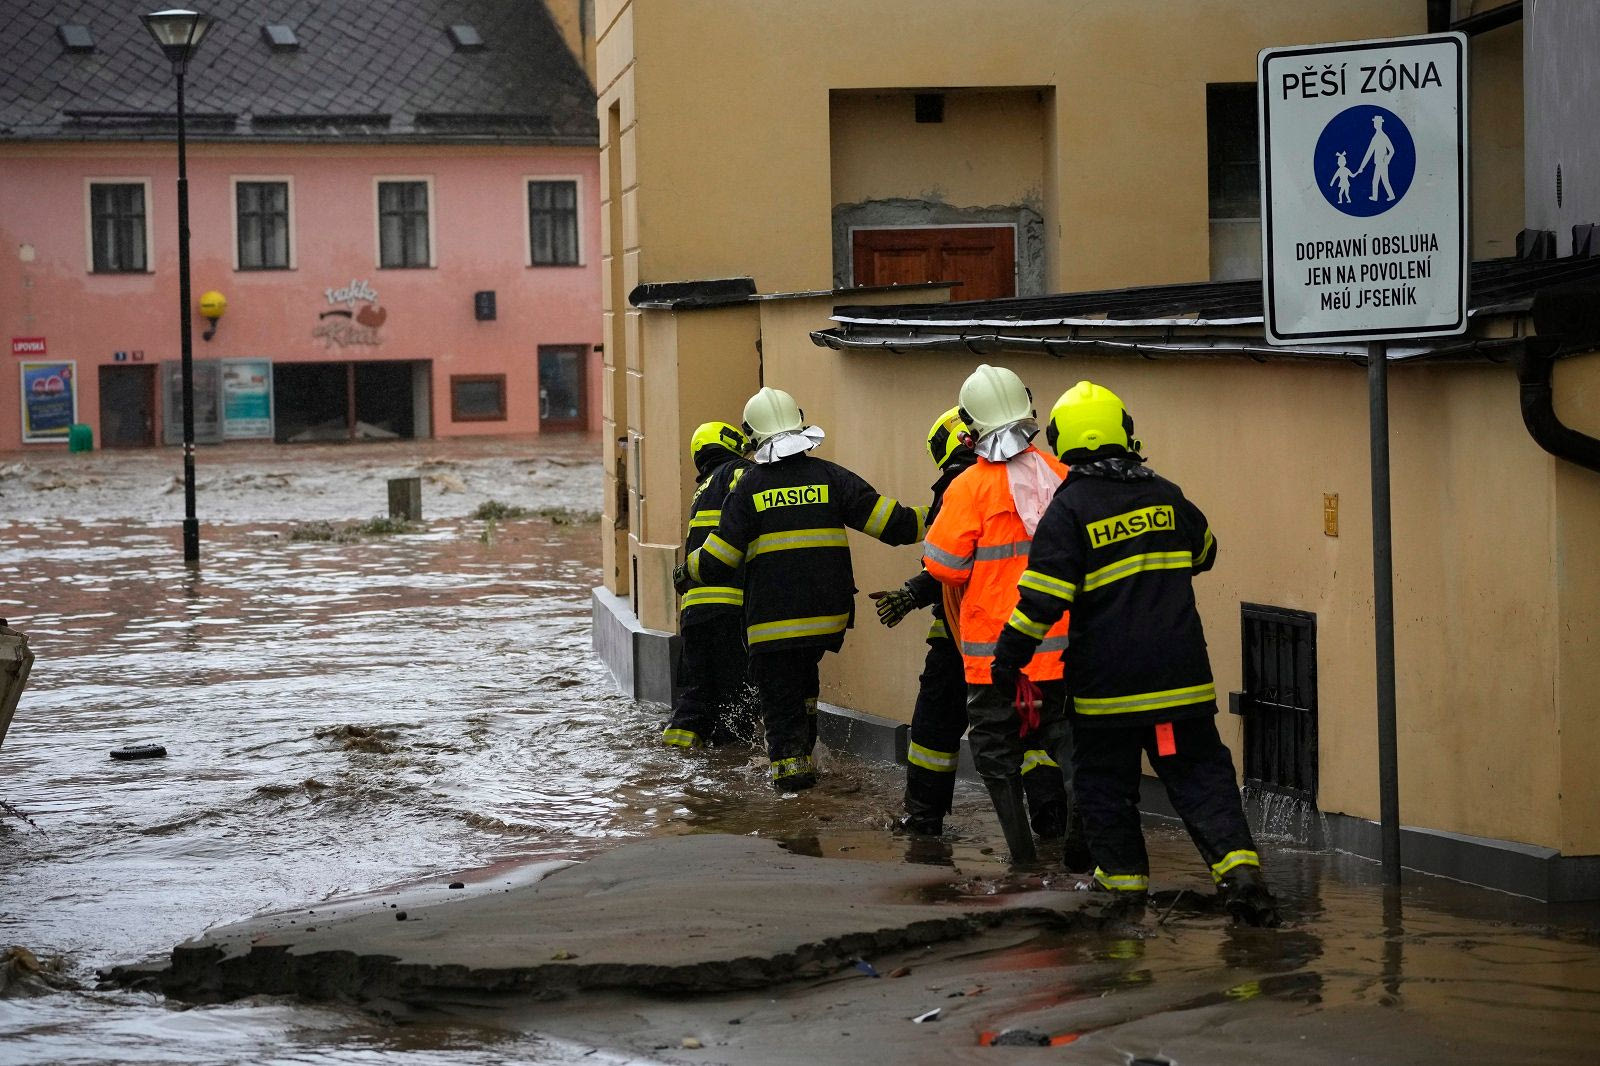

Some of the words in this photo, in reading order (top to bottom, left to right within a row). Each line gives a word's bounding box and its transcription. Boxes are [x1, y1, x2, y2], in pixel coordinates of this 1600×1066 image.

[1282, 62, 1346, 100] PĚŠÍ
[1360, 58, 1442, 94] ZÓNA
[1296, 234, 1367, 260] DOPRAVNÍ
[1372, 233, 1439, 255] OBSLUHA
[1304, 266, 1331, 286] JEN
[1336, 264, 1356, 284] NA
[1361, 256, 1431, 281] POVOLENÍ
[1320, 287, 1351, 311] MěÚ
[762, 485, 821, 508] HASIČI
[1092, 508, 1172, 544] HASIČI
